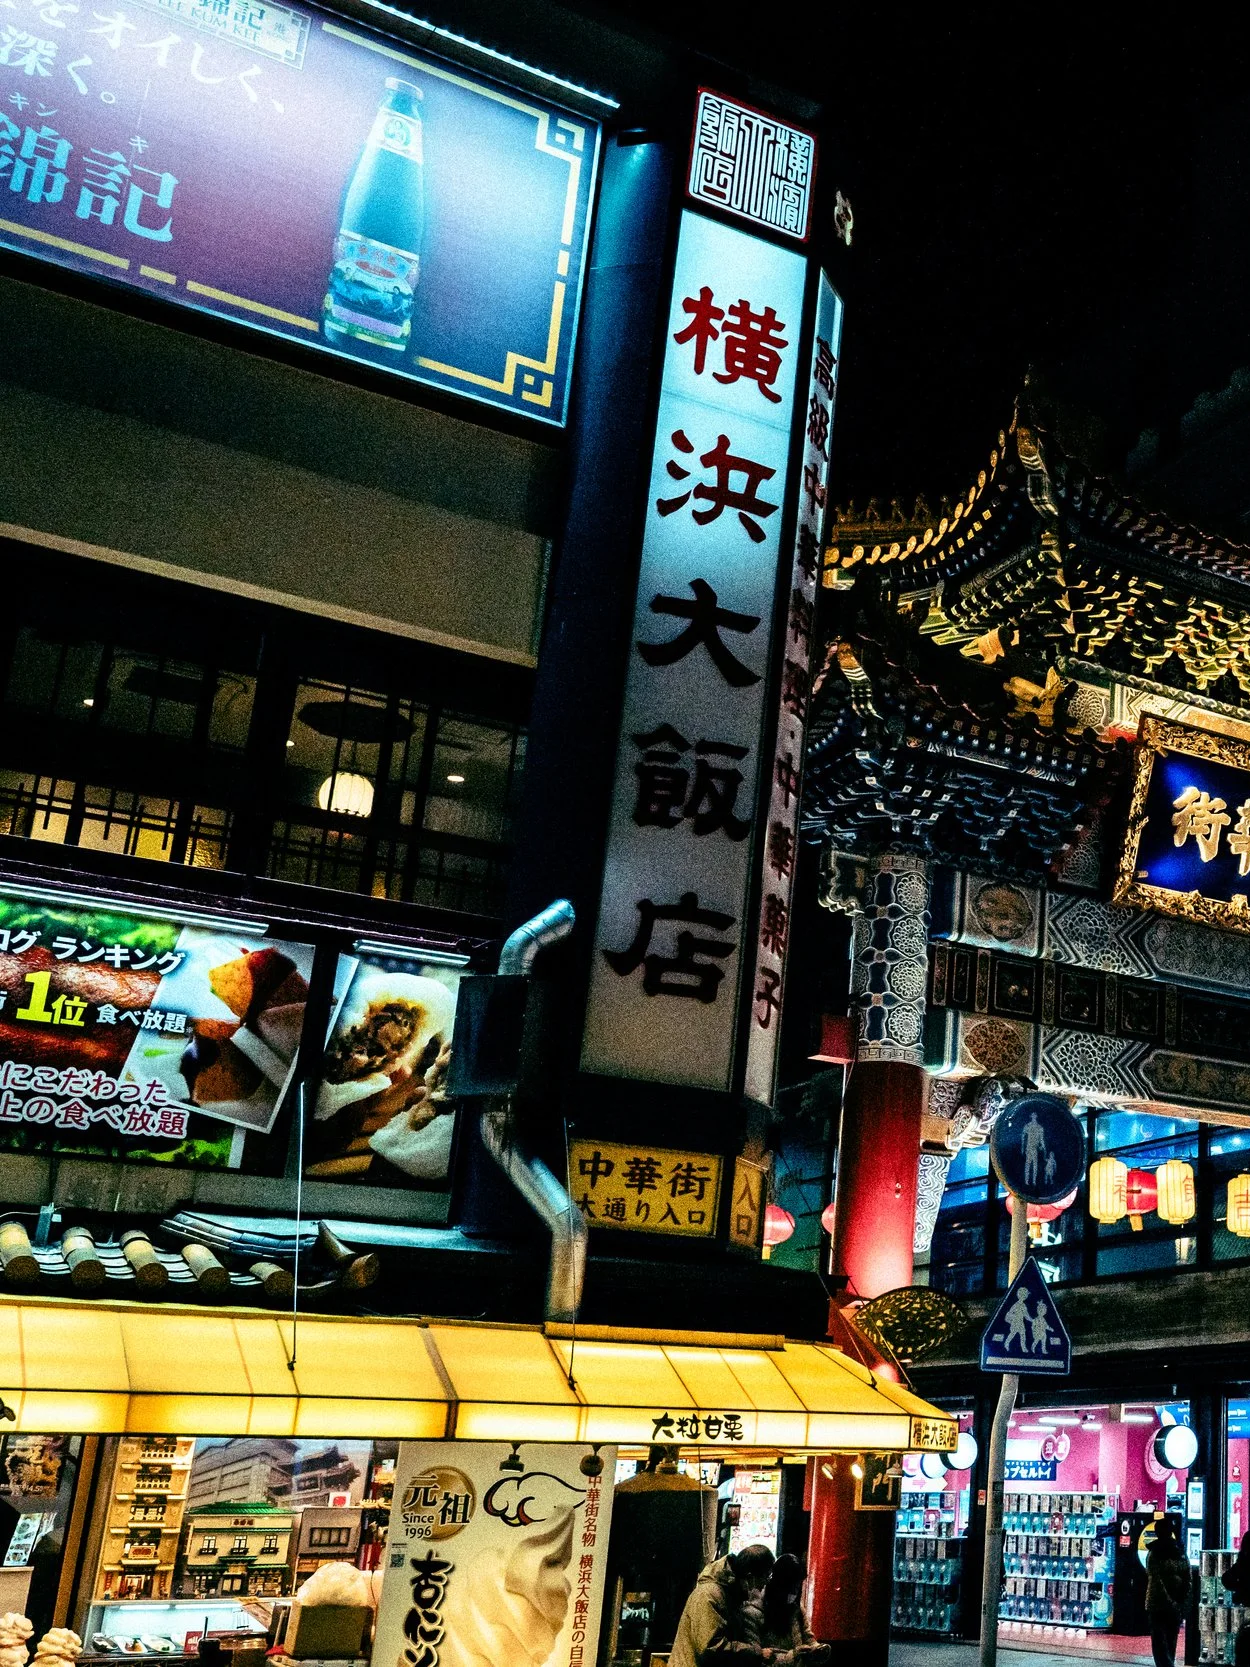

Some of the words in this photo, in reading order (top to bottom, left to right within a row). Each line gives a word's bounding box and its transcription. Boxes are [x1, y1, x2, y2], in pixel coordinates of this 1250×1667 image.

[190, 8, 227, 29] KUM
[233, 24, 258, 42] KEE
[0, 0, 284, 113] をオイしく、
[8, 92, 59, 117] キン
[602, 286, 788, 1003] 横浜大飯店
[52, 936, 186, 976] ランキング
[16, 971, 88, 1027] 1位
[96, 1003, 189, 1034] 食べ放題
[578, 1151, 711, 1201] 中華街
[577, 1193, 705, 1226] 大通り入口
[736, 1172, 755, 1237] 入口
[652, 1412, 744, 1441] 大粒甘栗
[402, 1512, 434, 1525] Since
[403, 1474, 474, 1526] 元祖
[582, 1476, 602, 1547] 中華街名物
[404, 1526, 432, 1539] 1996
